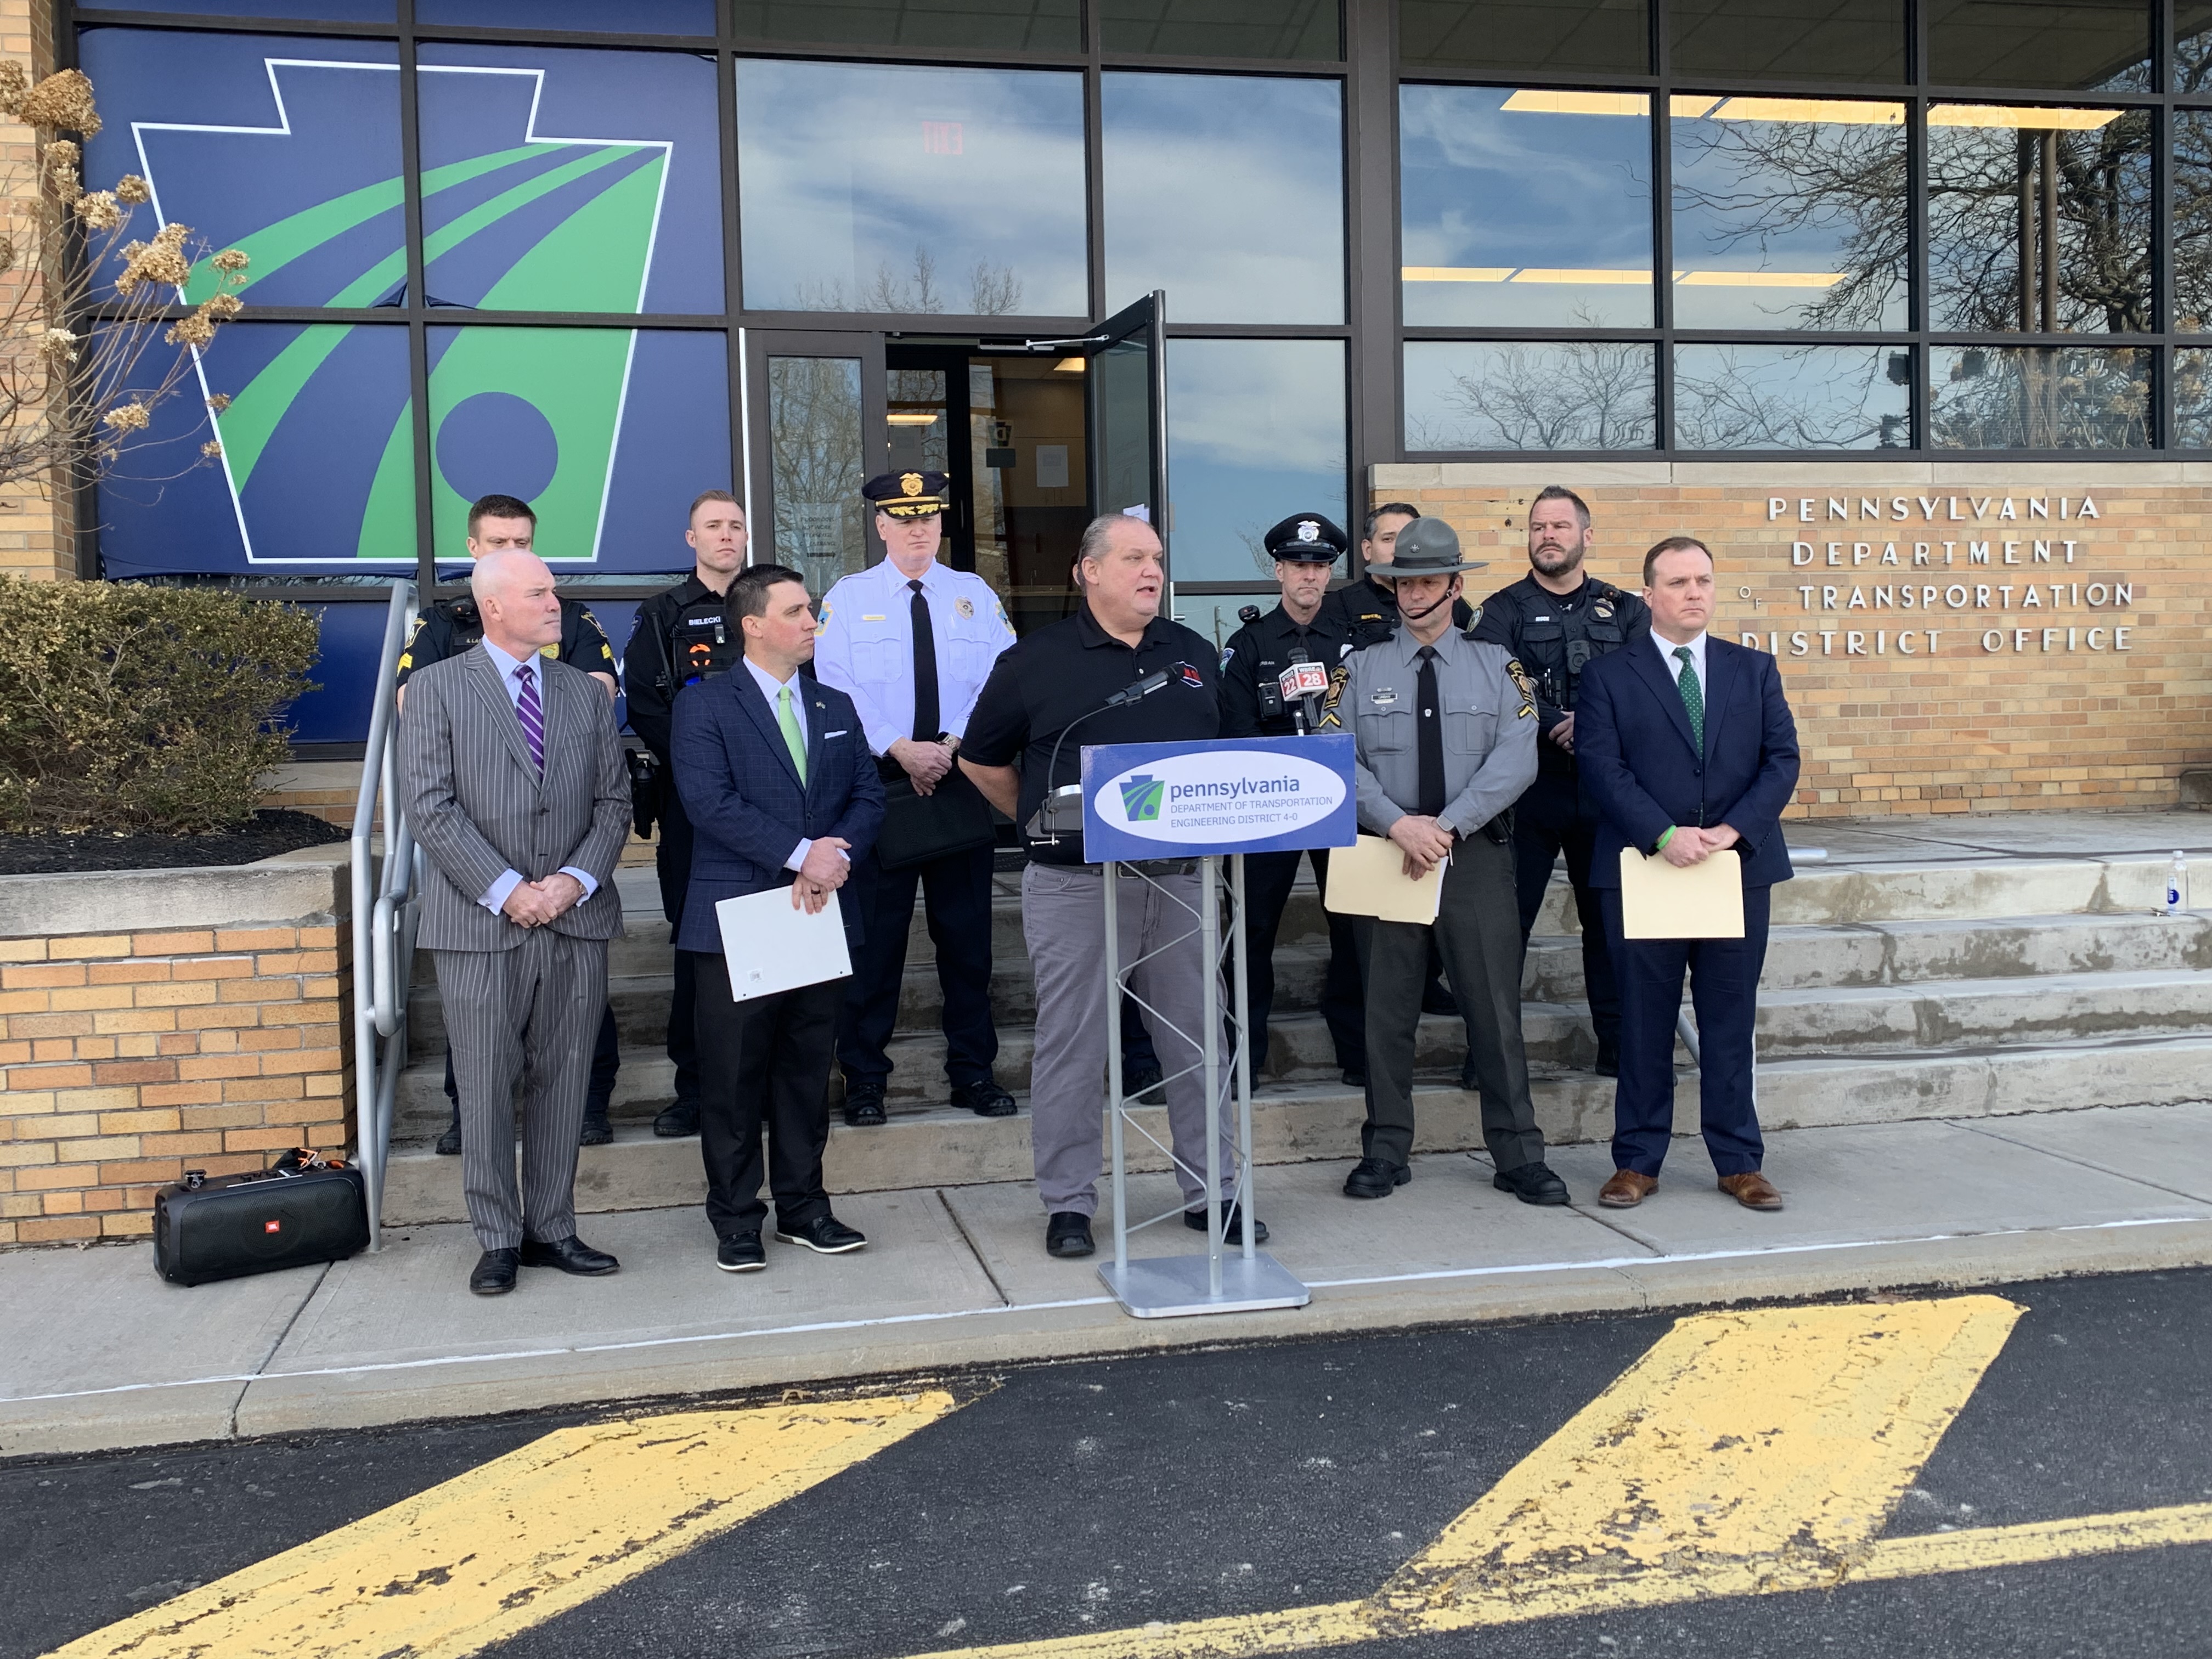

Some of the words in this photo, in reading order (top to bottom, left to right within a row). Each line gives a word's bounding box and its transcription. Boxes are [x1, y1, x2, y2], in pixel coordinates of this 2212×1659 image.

[1768, 496, 2101, 522] PENNSYLVANIA
[1793, 540, 2077, 566] DEPARTMENT
[1739, 586, 1762, 609] OF
[1799, 582, 2133, 609] TRANSPORTATION
[689, 616, 720, 625] BIELECKI
[1742, 631, 1942, 656] DISTRICT
[1982, 627, 2132, 652] OFFICE
[1284, 678, 1296, 695] 22
[1302, 673, 1322, 686] 28
[1171, 775, 1300, 802] pennsylvania
[1171, 802, 1234, 814] DEPARTMENT
[1235, 802, 1248, 810] OF
[1250, 797, 1333, 809] TRANSPORTATION
[1171, 816, 1235, 828] ENGINEERING
[1238, 814, 1280, 824] DISTRICT
[1283, 813, 1298, 822] 4-0
